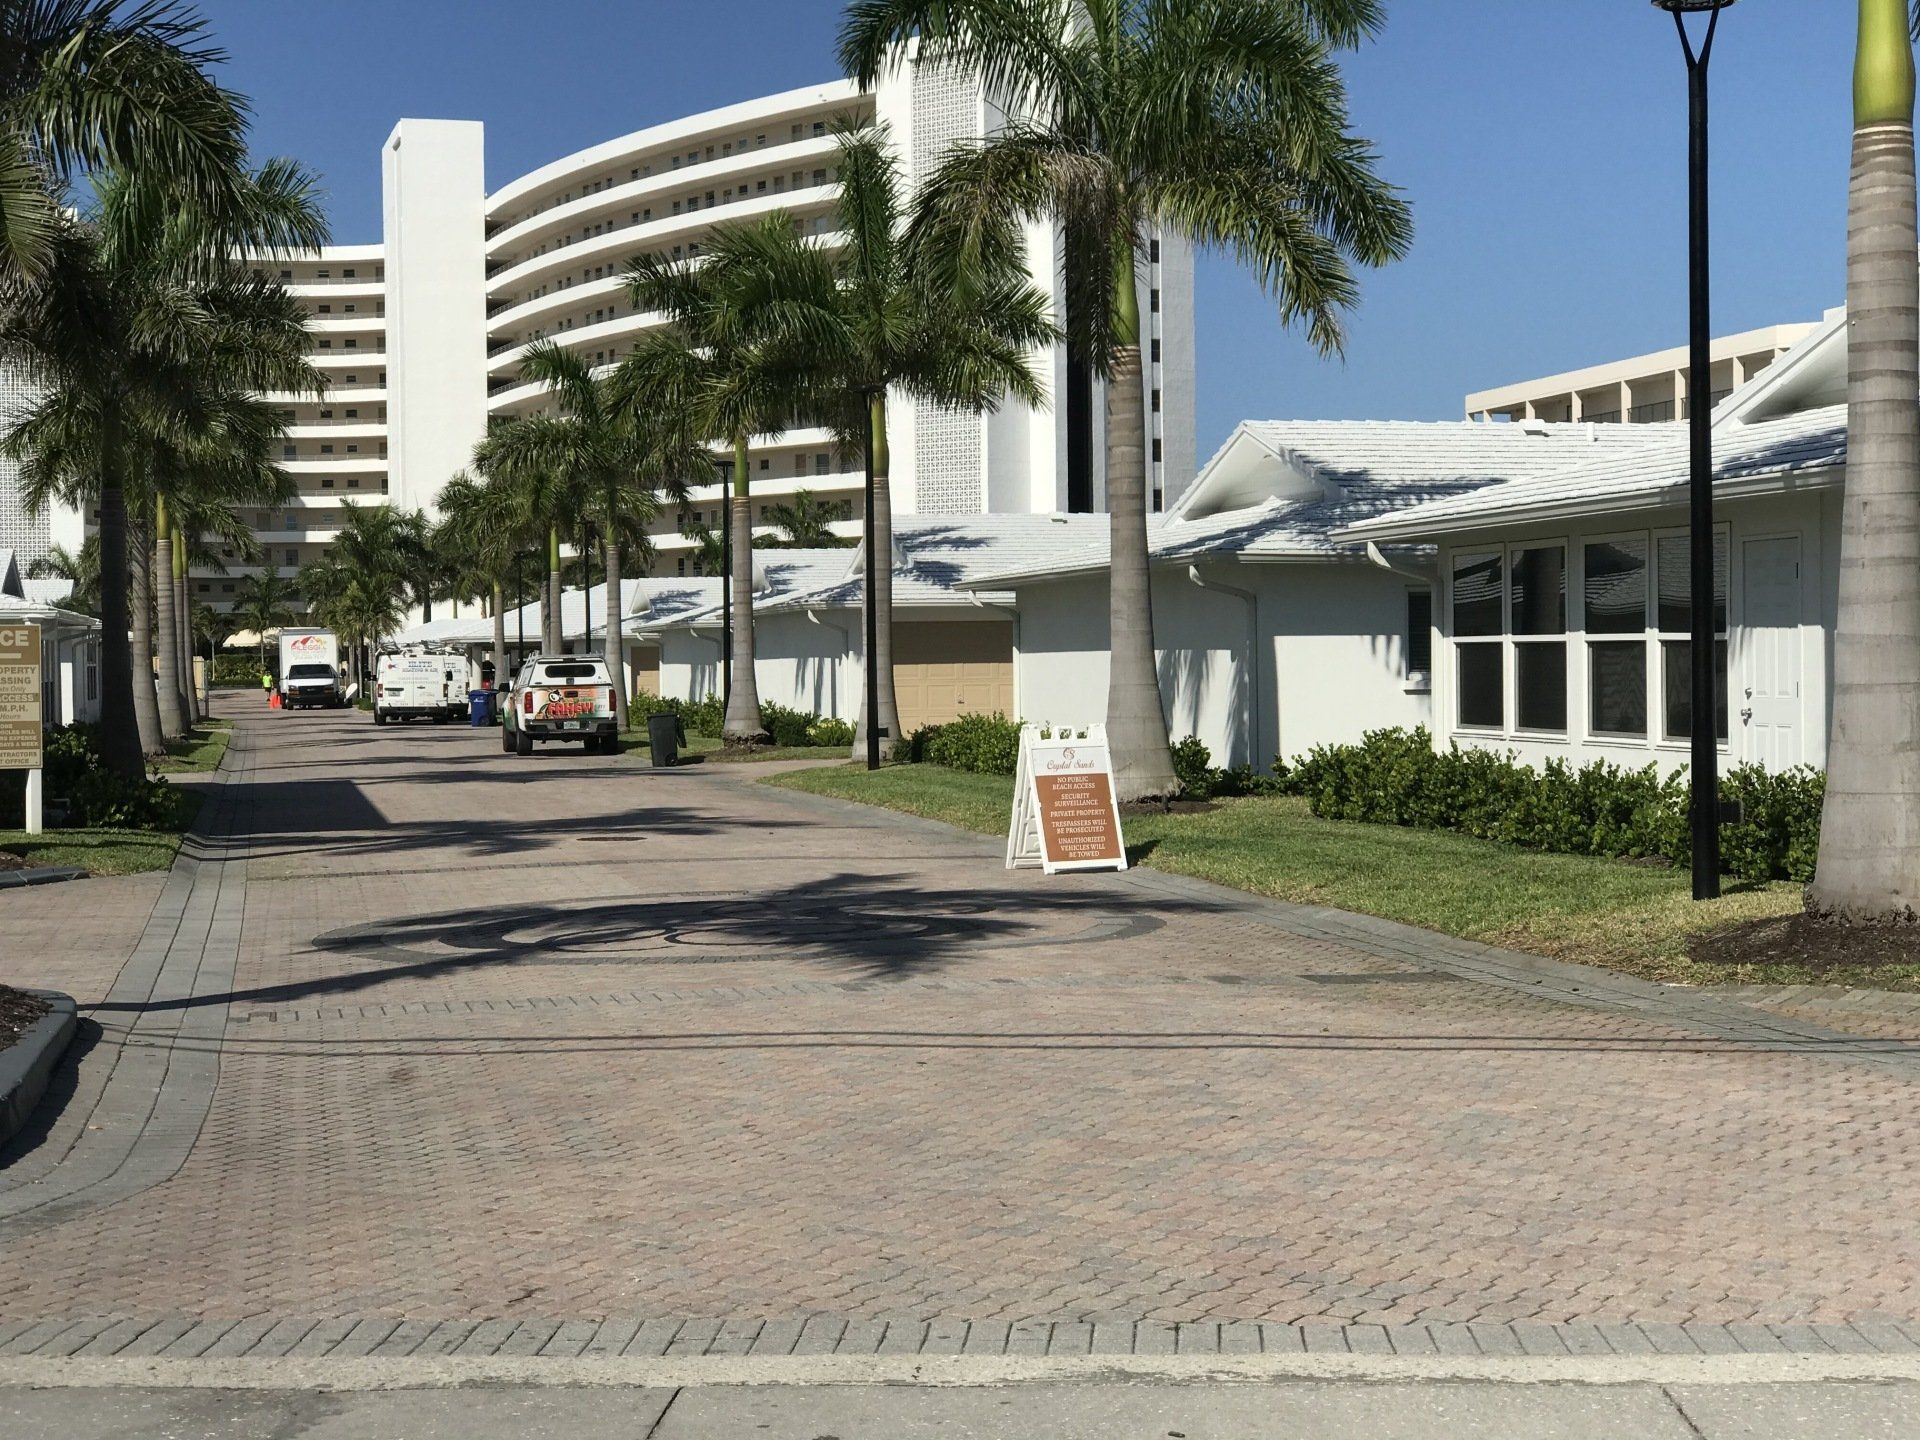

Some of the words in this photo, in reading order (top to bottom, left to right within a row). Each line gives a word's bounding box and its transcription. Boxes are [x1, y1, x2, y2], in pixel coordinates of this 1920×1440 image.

[0, 694, 34, 702] CCESS
[1061, 792, 1090, 800] SECURITY
[1054, 799, 1099, 807] SURVEILLANCE
[1050, 810, 1076, 818] PRIVATE
[1076, 809, 1106, 817] PROPERTY
[1051, 819, 1091, 828] TRESPASSERS
[1091, 818, 1108, 826] WILL
[1066, 825, 1105, 834] PROSECUTED
[1058, 835, 1106, 845] UNAUTHORIZED
[1060, 844, 1090, 852] VEHICLES
[1078, 850, 1100, 858] TOWED
